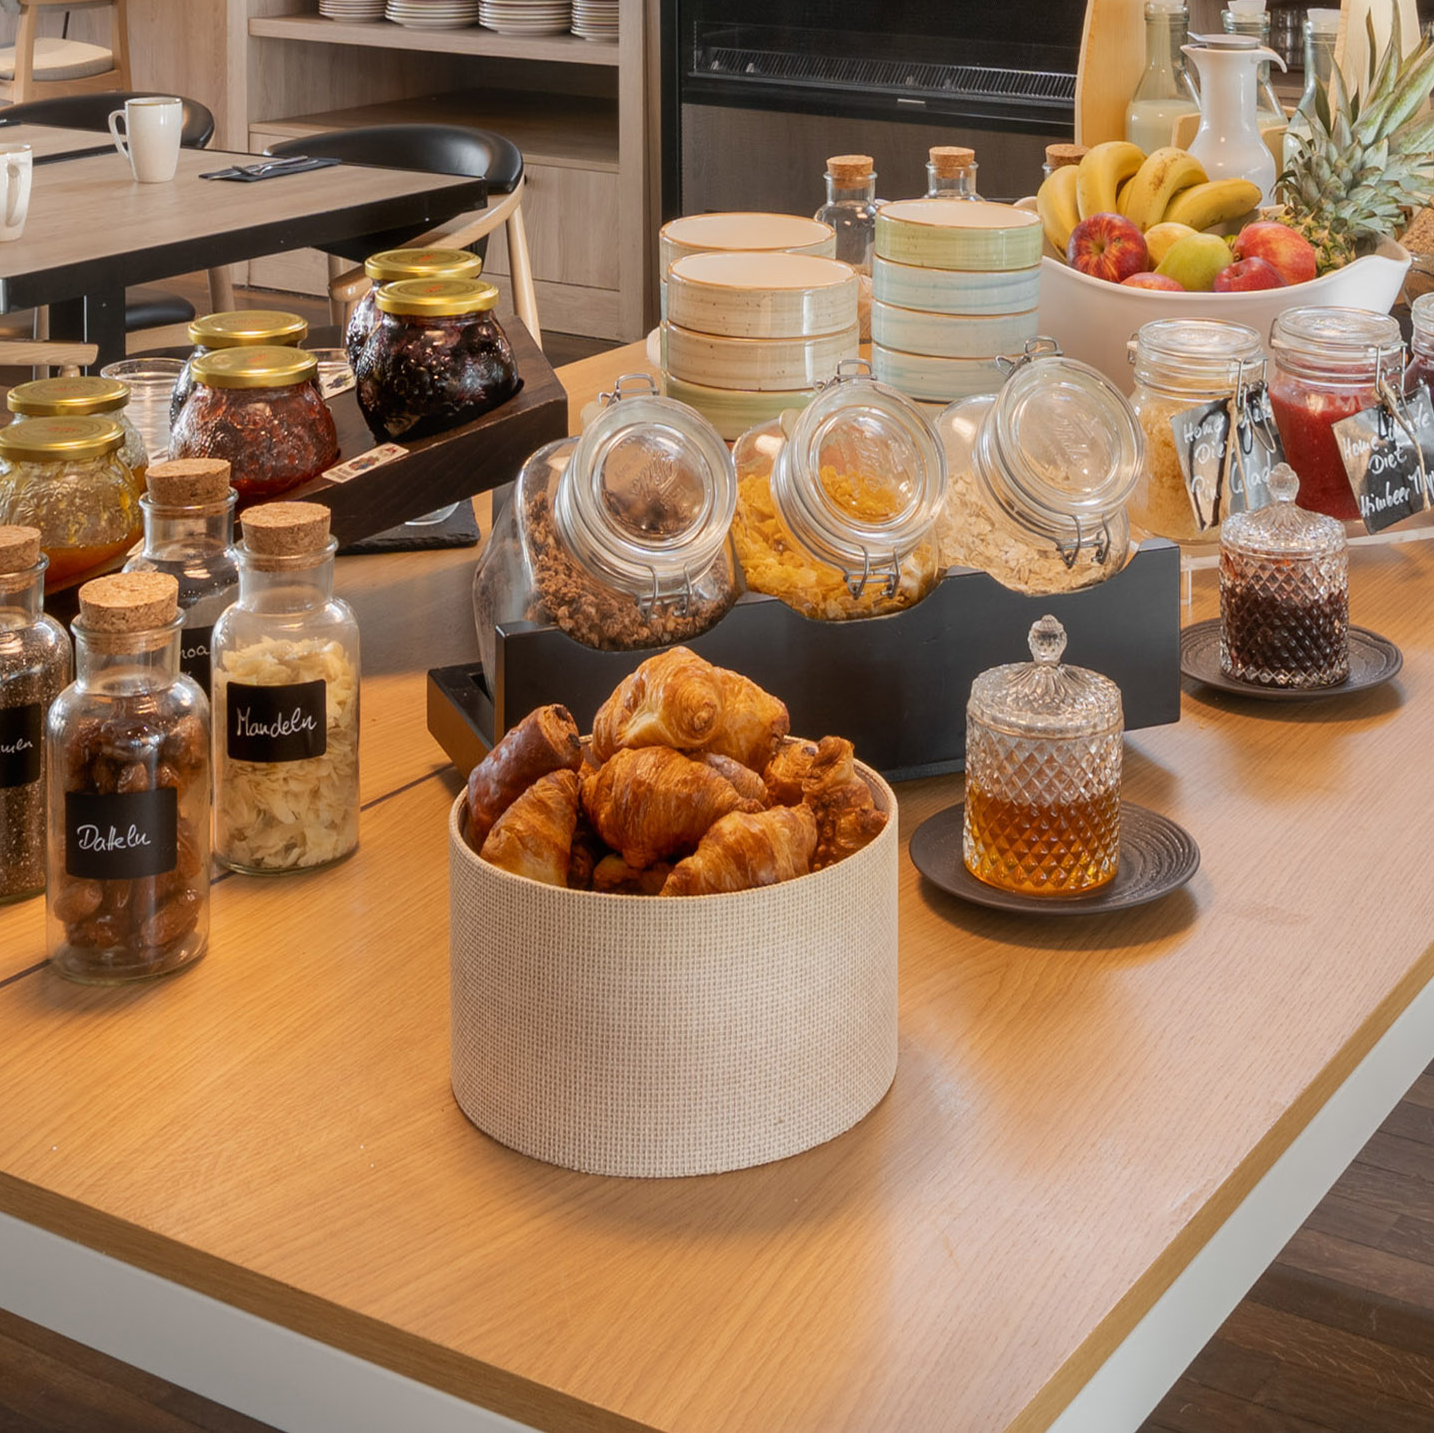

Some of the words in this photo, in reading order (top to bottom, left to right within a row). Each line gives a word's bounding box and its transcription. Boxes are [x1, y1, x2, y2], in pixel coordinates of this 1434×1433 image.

[1368, 446, 1407, 475] Diet
[1360, 481, 1410, 518] Himbeer
[236, 706, 318, 738] Mandeln
[76, 823, 152, 853] Datteln
